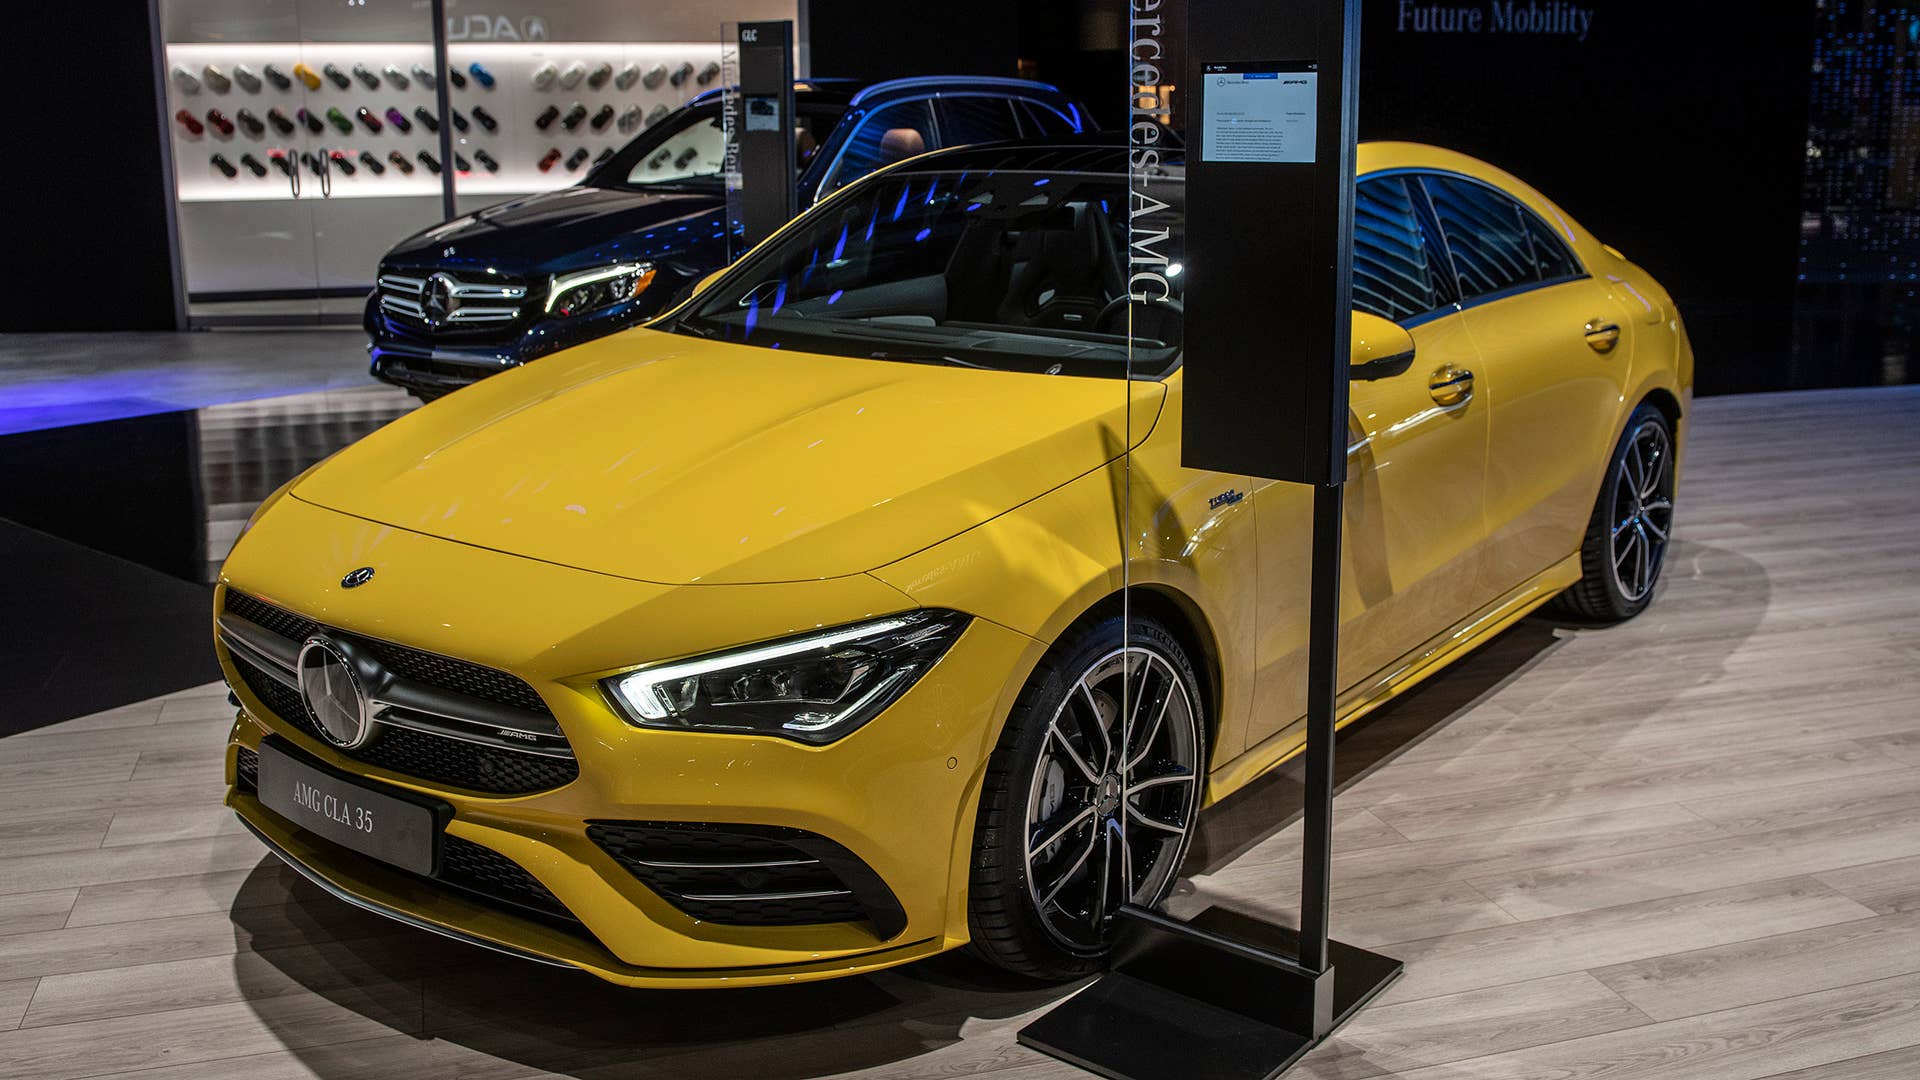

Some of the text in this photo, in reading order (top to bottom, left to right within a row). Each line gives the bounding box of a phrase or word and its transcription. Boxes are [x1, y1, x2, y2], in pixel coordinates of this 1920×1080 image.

[1397, 0, 1594, 41] Future Mobility
[1130, 0, 1171, 304] ercedes-AMG
[293, 780, 373, 833] AMG CLA 35
